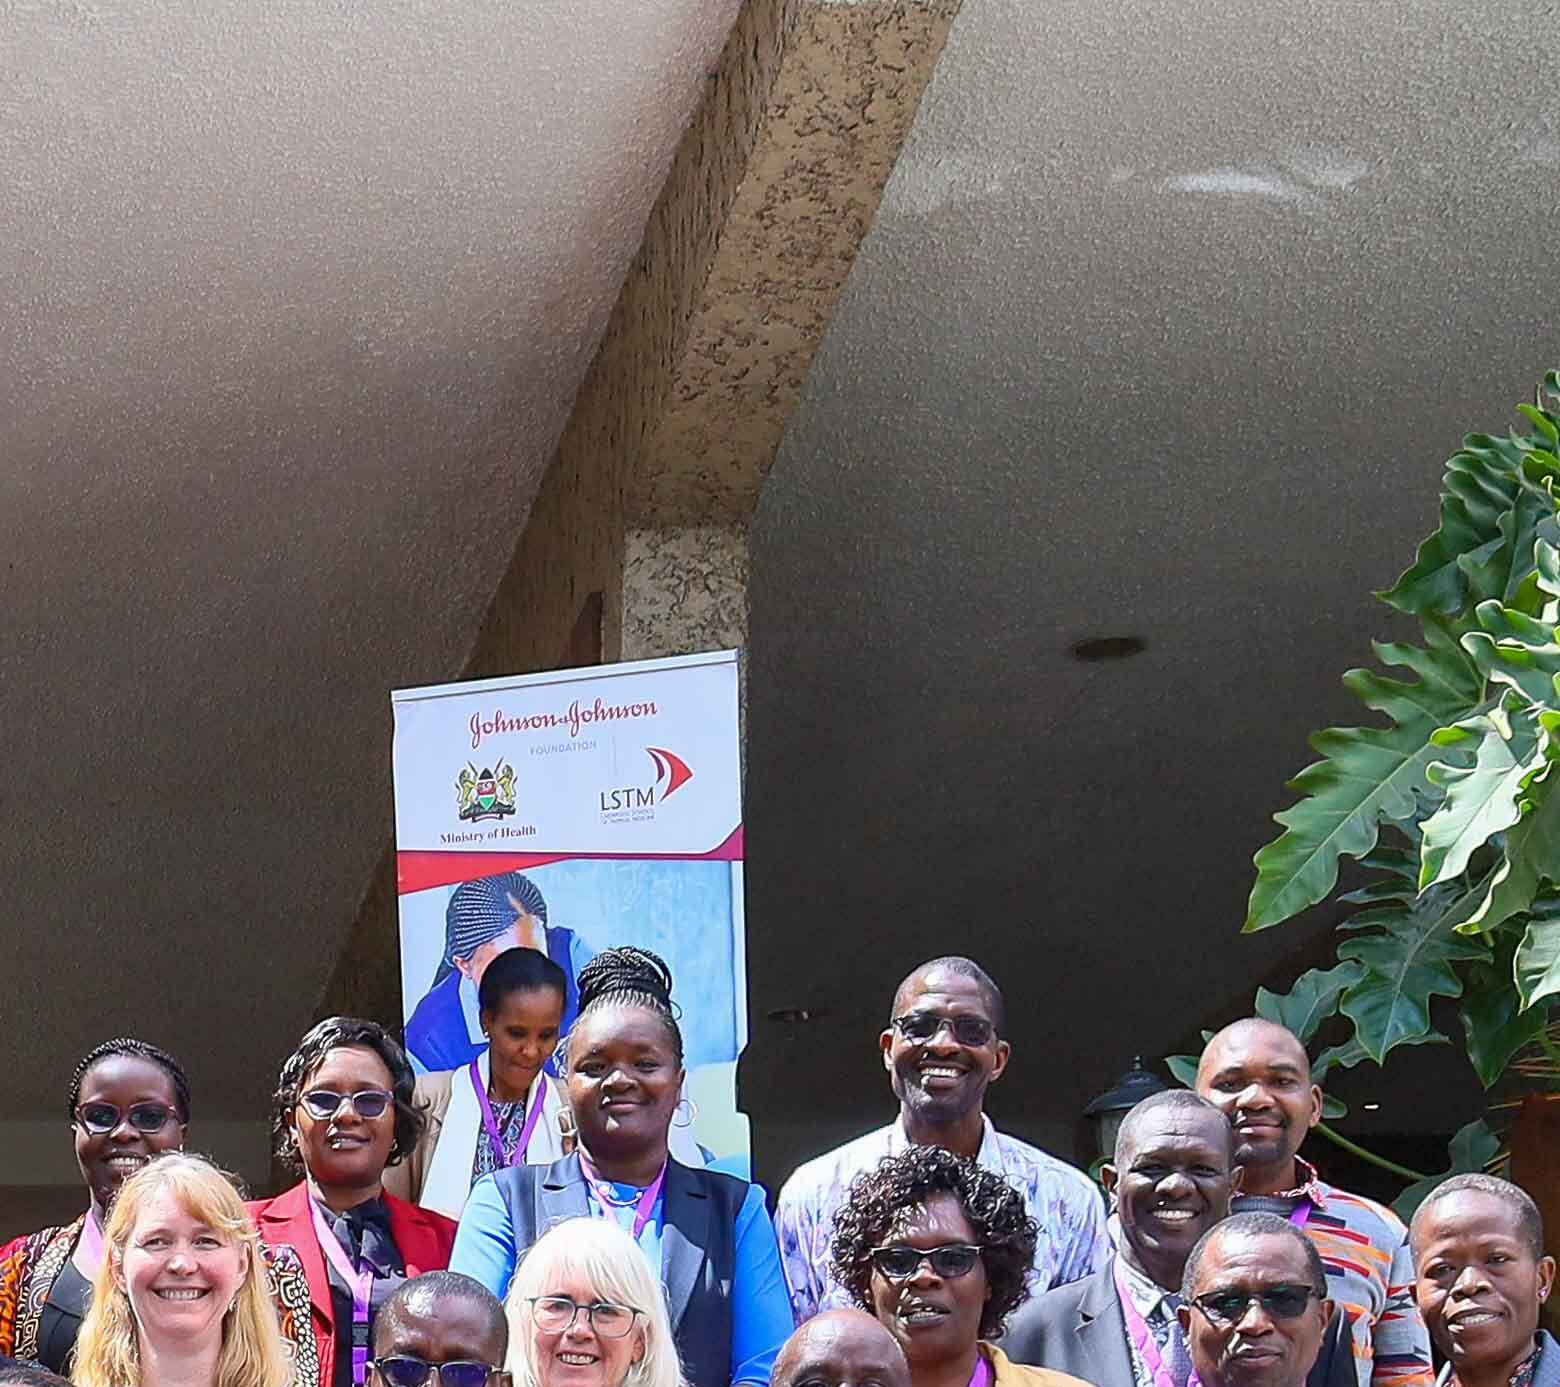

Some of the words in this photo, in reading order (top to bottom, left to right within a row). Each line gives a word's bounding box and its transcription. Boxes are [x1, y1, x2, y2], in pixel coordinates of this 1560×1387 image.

[530, 740, 597, 756] FOUNDATION
[600, 786, 654, 811] LSTM
[440, 829, 484, 845] Ministry
[488, 828, 497, 840] of
[501, 825, 536, 839] Health
